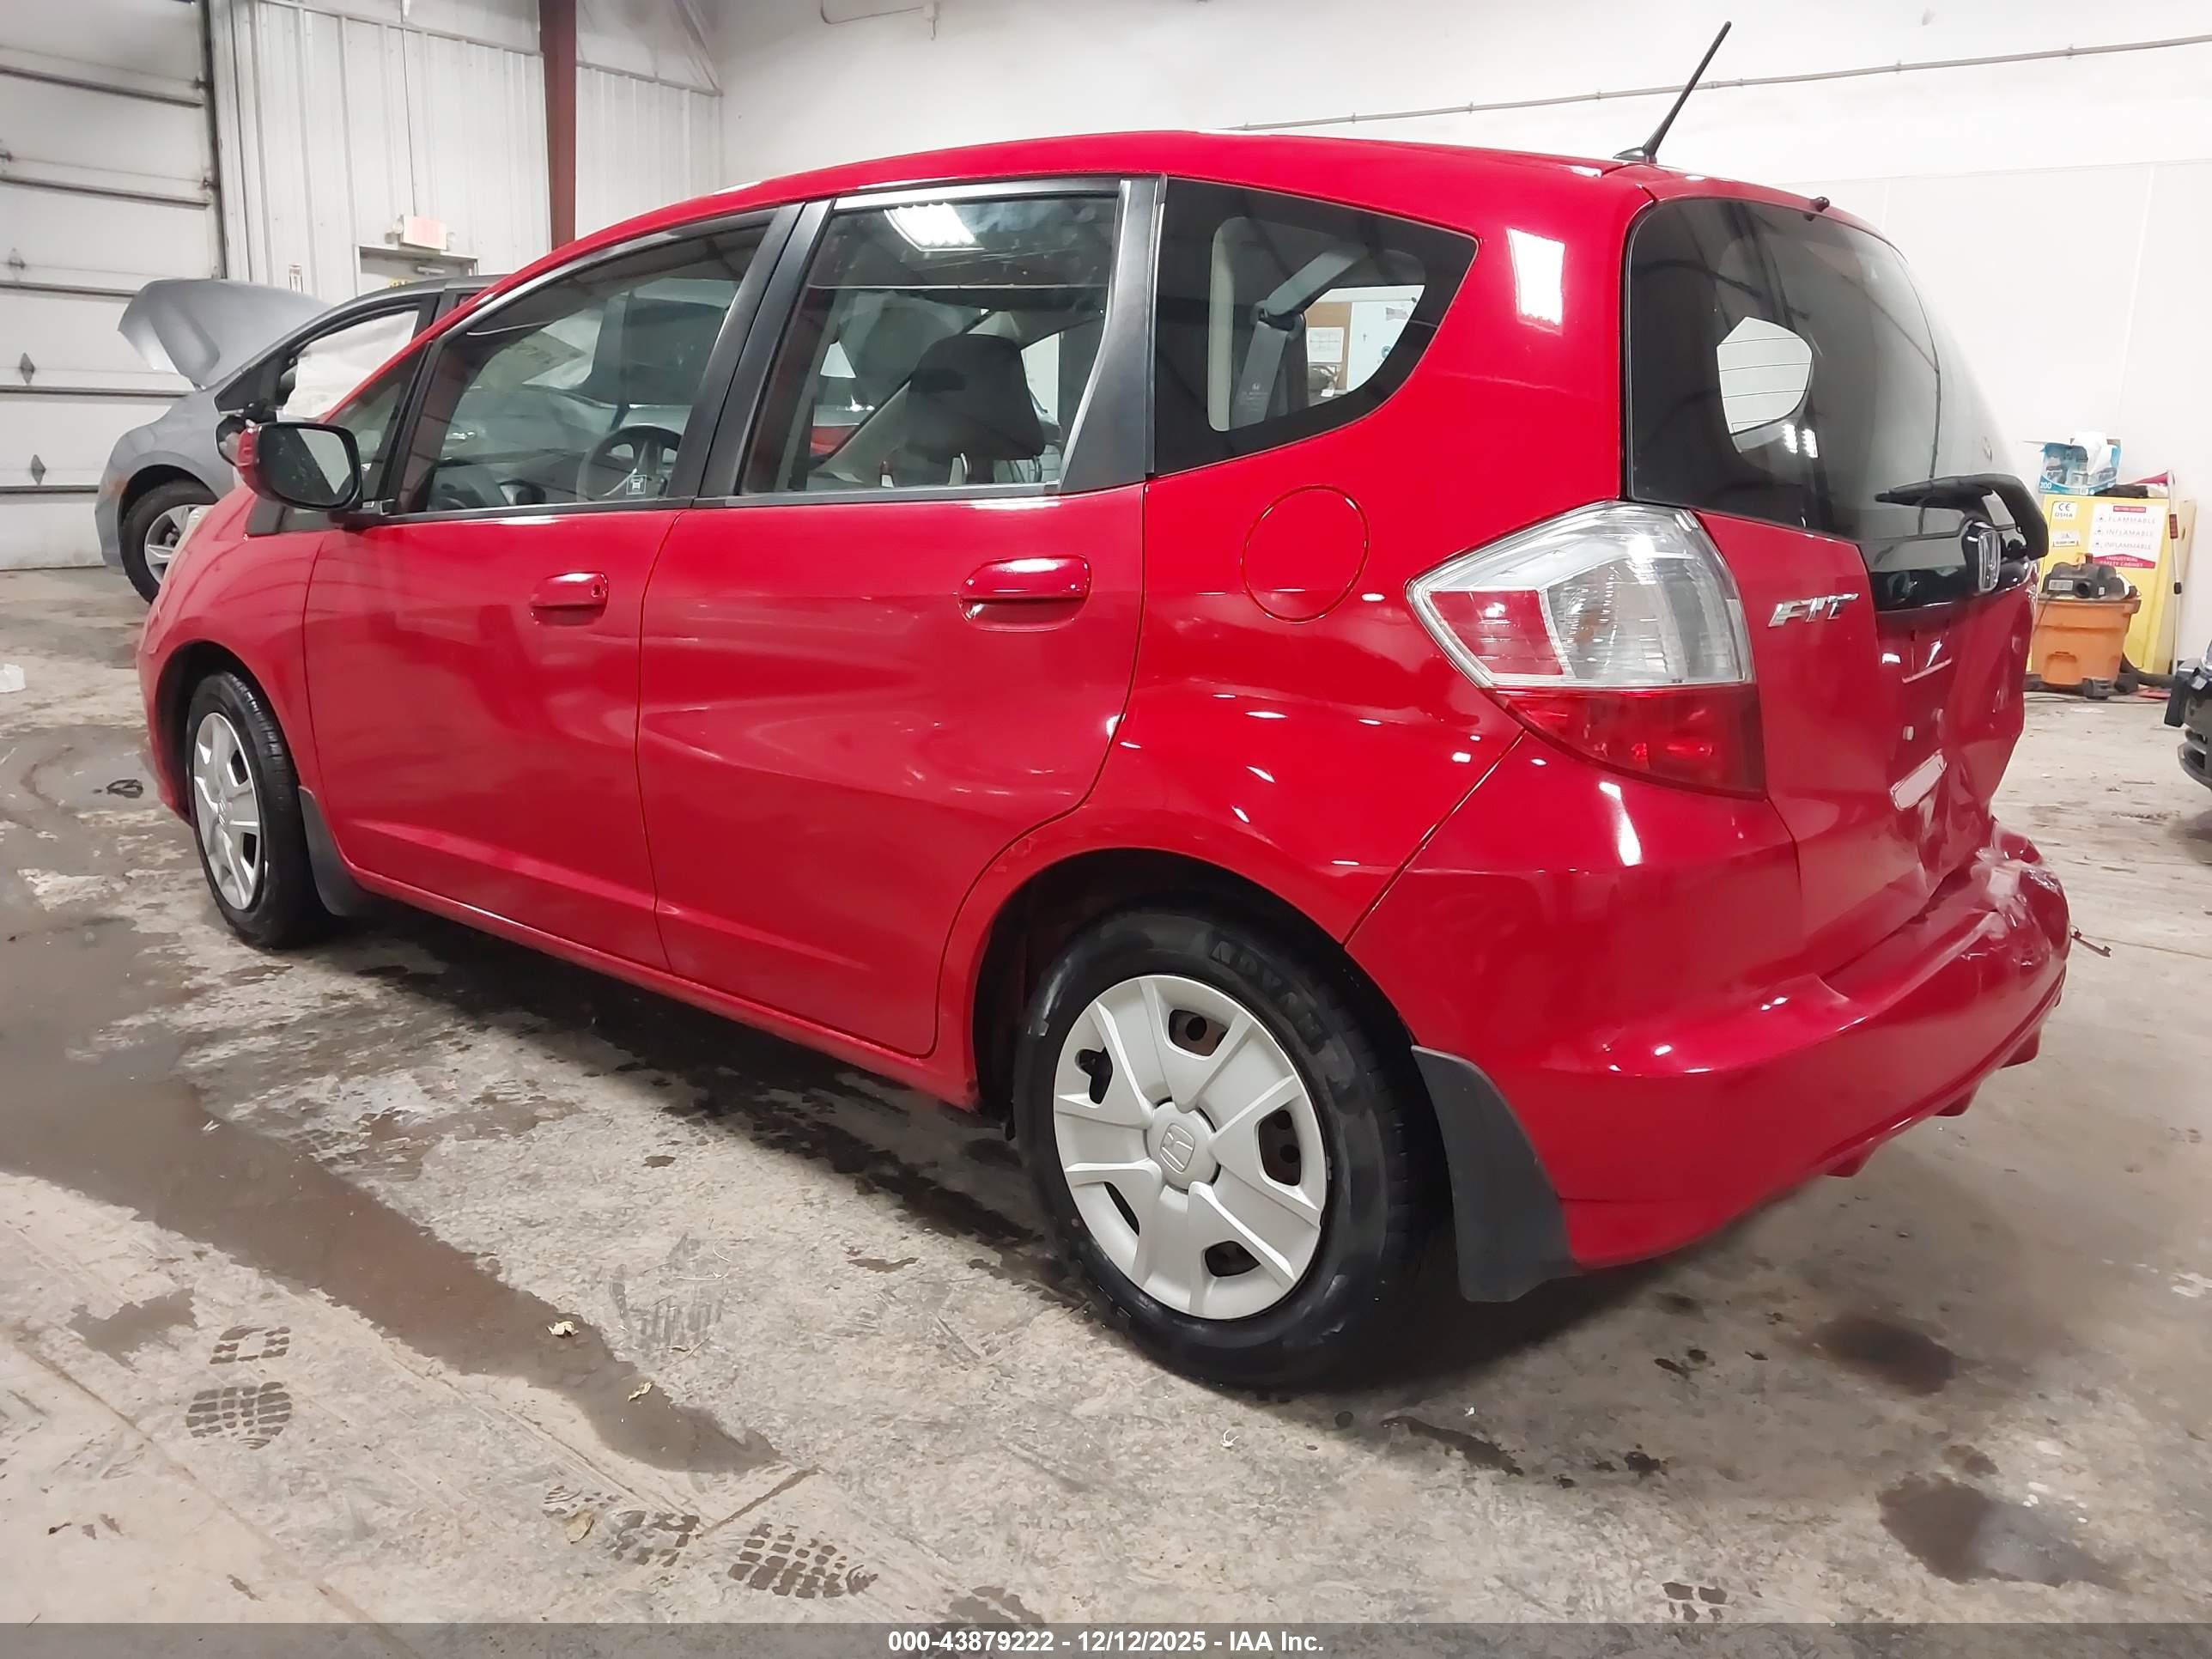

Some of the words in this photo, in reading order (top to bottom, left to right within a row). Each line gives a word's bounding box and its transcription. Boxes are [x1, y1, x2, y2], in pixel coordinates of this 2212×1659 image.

[2108, 515, 2156, 524] FLAMMABLE
[2106, 528, 2154, 537] INFLAMABLE
[2103, 541, 2152, 550] INFLAMMABLE
[1767, 592, 1859, 628] FIT
